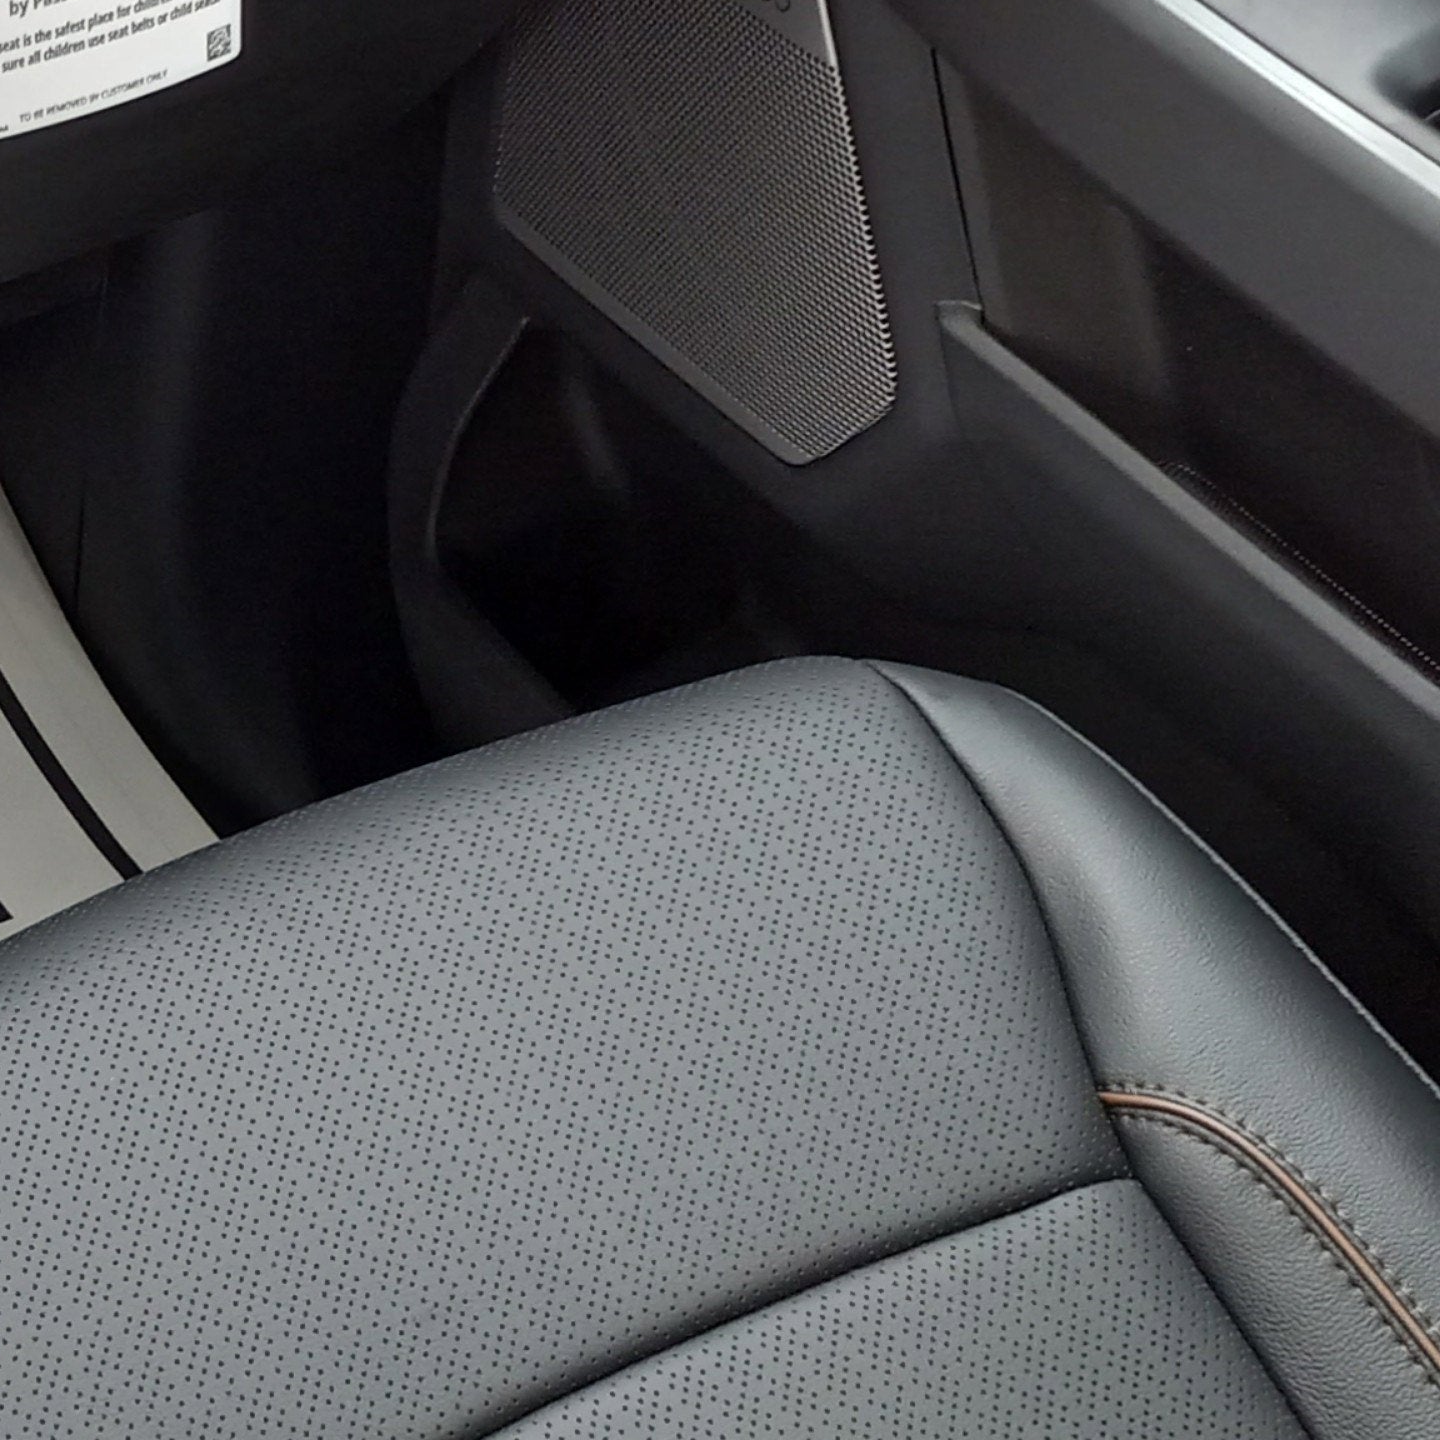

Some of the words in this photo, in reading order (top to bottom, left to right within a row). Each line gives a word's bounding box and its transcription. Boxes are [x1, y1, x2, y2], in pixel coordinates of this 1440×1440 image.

[9, 0, 29, 17] by
[23, 33, 33, 47] is
[34, 27, 53, 44] the
[54, 19, 86, 40] safest
[87, 10, 114, 32] place
[116, 4, 133, 19] for
[1, 57, 26, 73] sure
[28, 50, 41, 65] all
[43, 37, 85, 61] children
[87, 33, 106, 49] use
[107, 25, 129, 43] seat
[131, 16, 155, 37] belts
[157, 12, 168, 27] or
[170, 4, 193, 23] child
